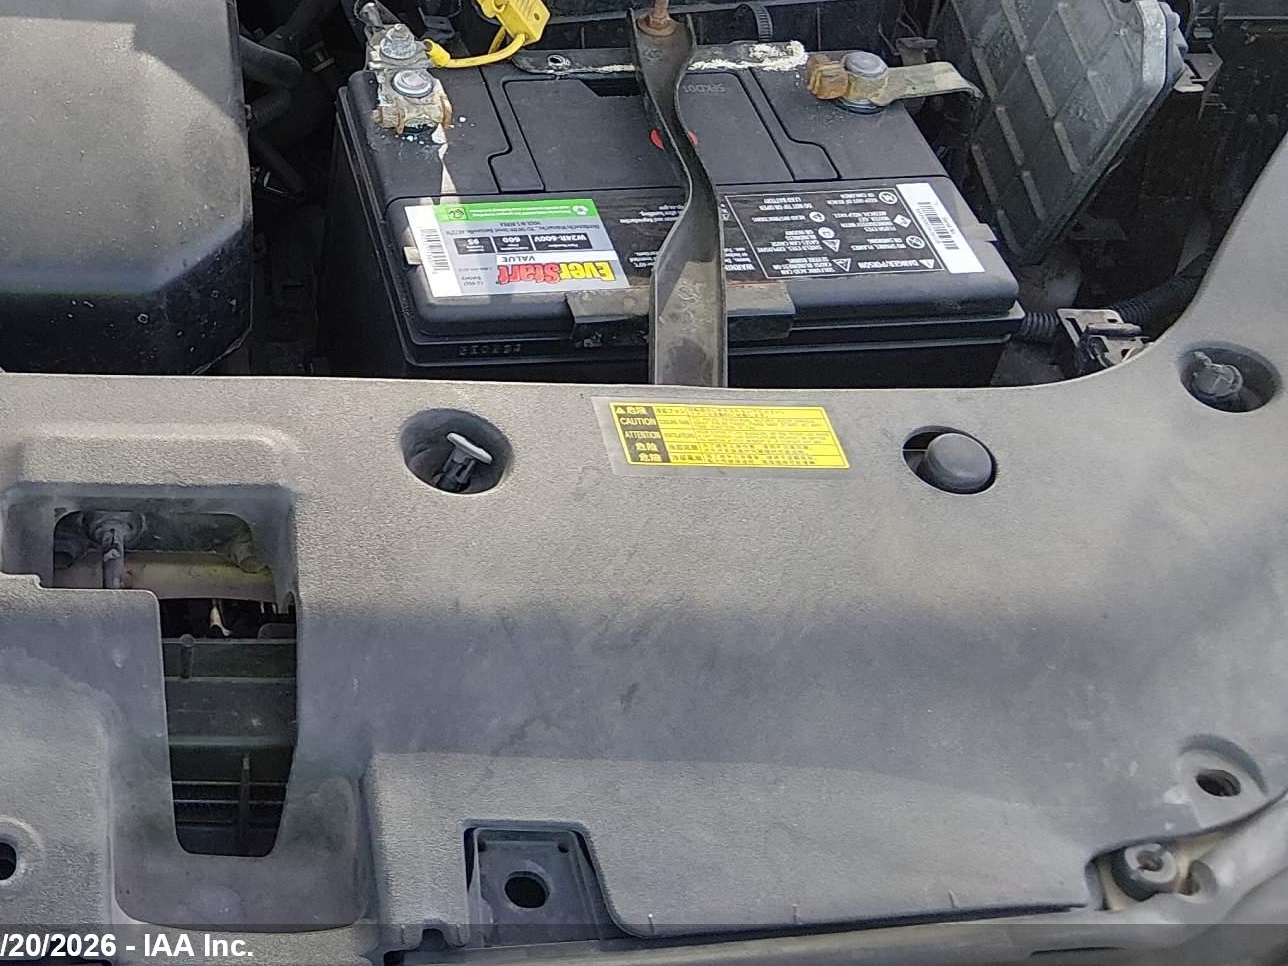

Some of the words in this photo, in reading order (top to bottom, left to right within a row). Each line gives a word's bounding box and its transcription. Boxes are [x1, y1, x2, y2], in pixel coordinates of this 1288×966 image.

[502, 255, 535, 263] VALUE
[499, 260, 616, 284] EverStart
[619, 417, 657, 426] CAUTION
[624, 430, 661, 439] ATTENTION
